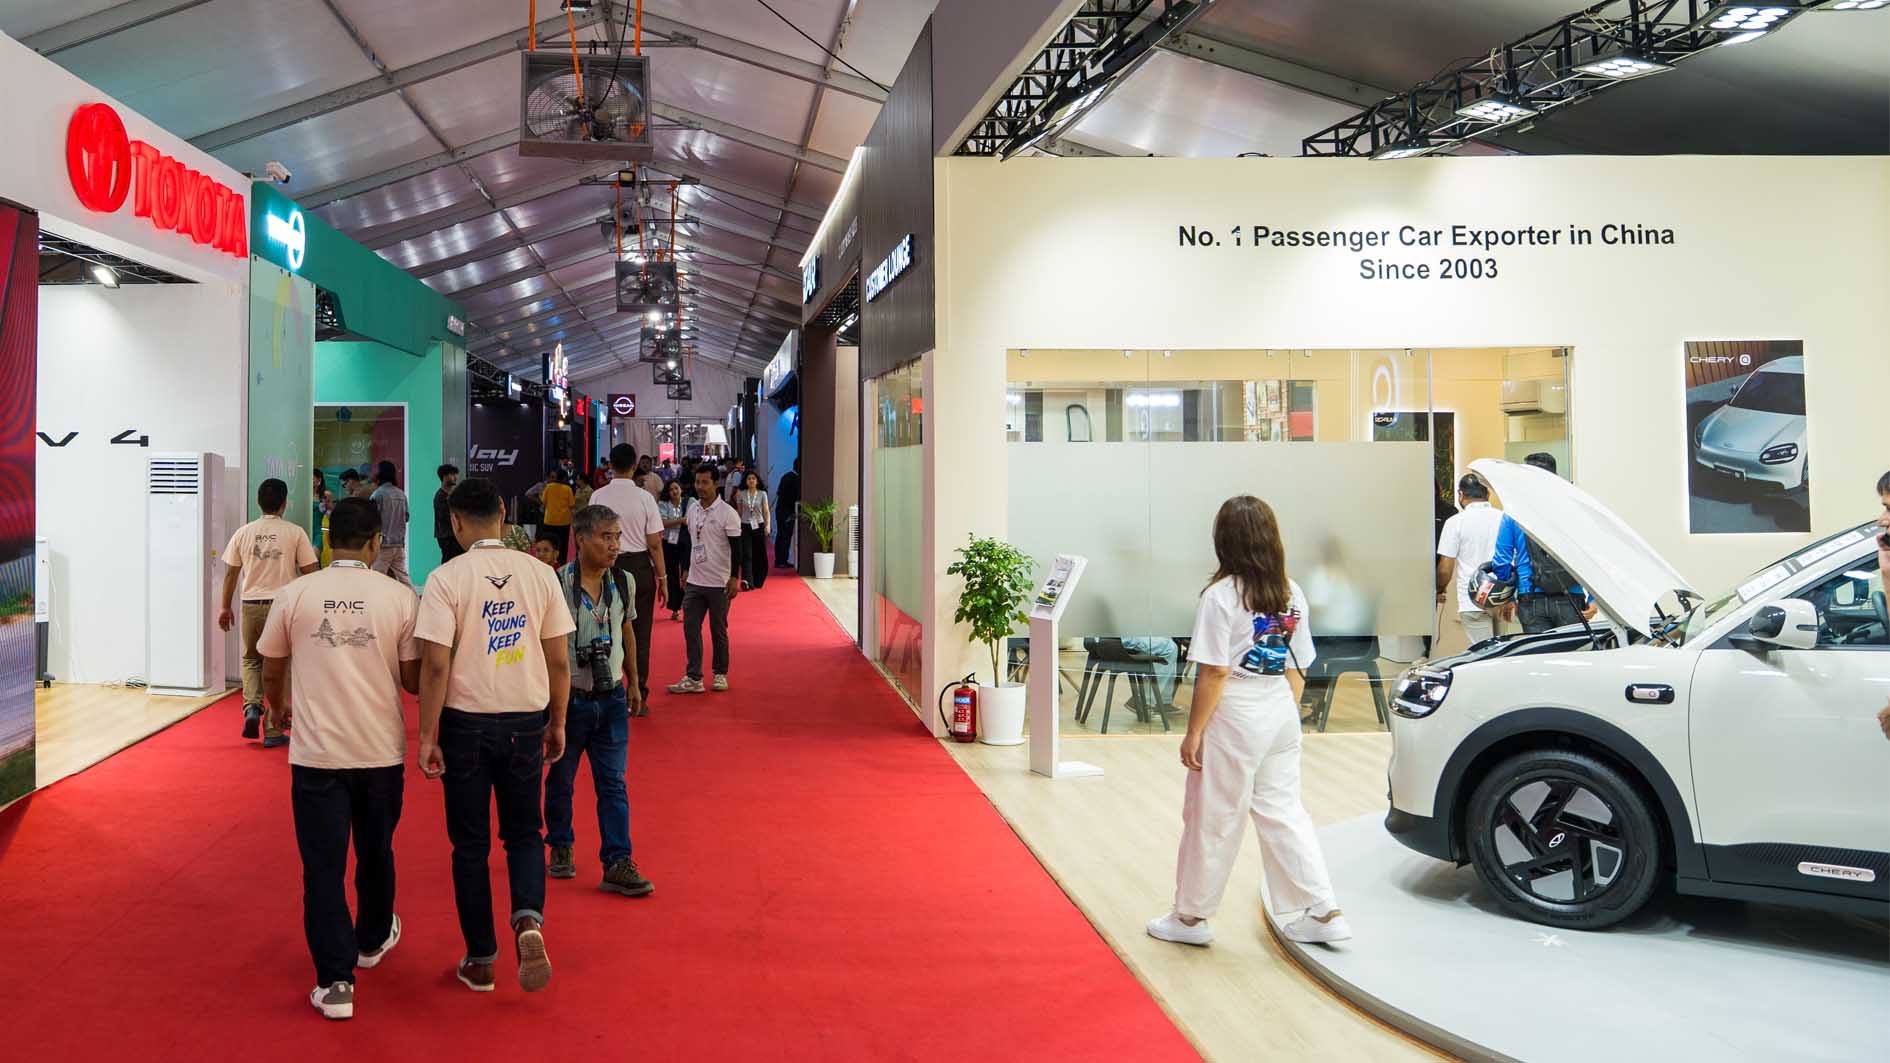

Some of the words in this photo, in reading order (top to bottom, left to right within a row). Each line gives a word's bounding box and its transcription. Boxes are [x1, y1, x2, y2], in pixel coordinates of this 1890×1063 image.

[130, 140, 248, 258] TOYOTA
[1179, 226, 1221, 247] No.
[1231, 226, 1241, 247] 1
[1254, 226, 1390, 251] Passenger
[1399, 225, 1443, 247] Car
[1452, 225, 1561, 251] Exporter
[1570, 224, 1592, 245] in
[1601, 223, 1675, 245] China
[1360, 259, 1430, 280] Since
[1440, 258, 1498, 280] 2003
[1690, 356, 1735, 364] CHERY
[324, 600, 365, 610] BAIC
[482, 600, 515, 619] KEEP
[487, 614, 526, 636] YOUNG
[487, 631, 522, 656] KEEP
[496, 645, 525, 670] FUN
[1810, 866, 1862, 878] CHERY
